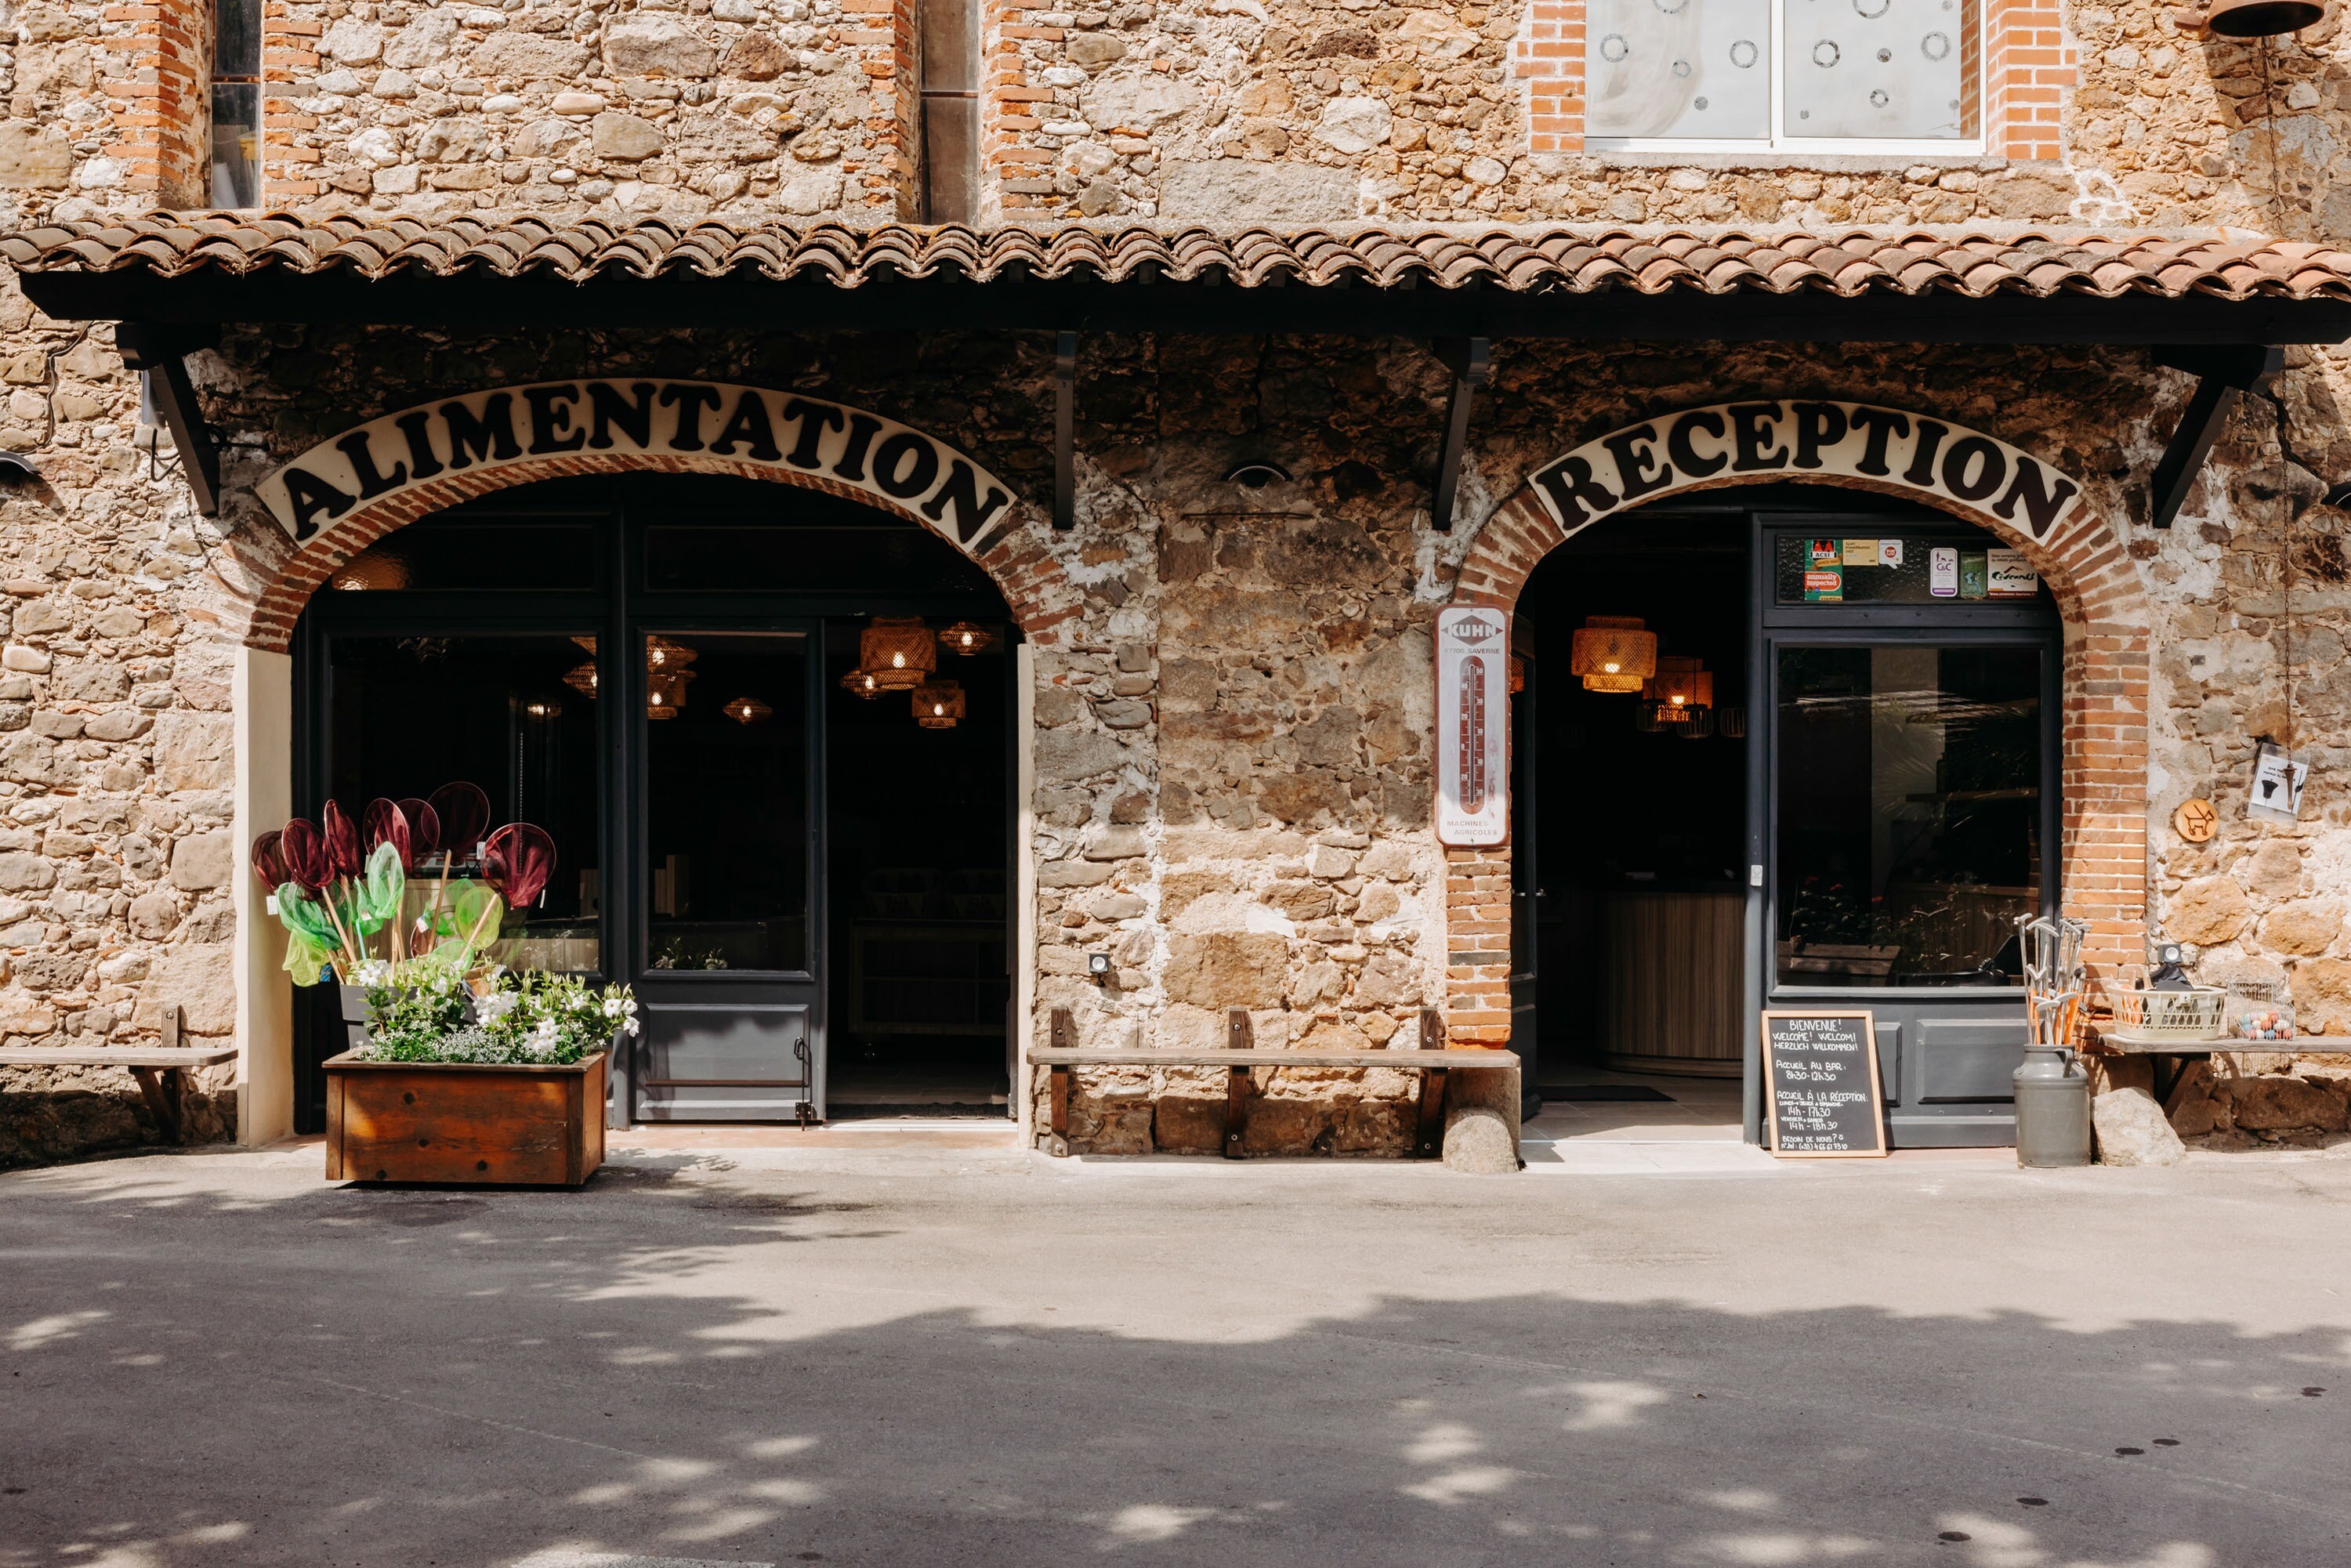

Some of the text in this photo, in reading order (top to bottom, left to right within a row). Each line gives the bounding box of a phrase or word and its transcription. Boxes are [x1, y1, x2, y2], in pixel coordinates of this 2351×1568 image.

[282, 382, 1009, 545] ALIMENTATION
[1534, 401, 2078, 538] RECEPTION
[1936, 563, 1951, 571] C&C
[1447, 624, 1496, 637] KUHN
[1789, 1019, 1842, 1032] BIENVENUE!
[1772, 1031, 1857, 1042] WELCOME! WELCOM!
[1810, 1062, 1823, 1070] AU
[1807, 1089, 1814, 1101] À
[1817, 1092, 1828, 1102] LA
[1788, 1106, 1802, 1116] 14h
[1808, 1106, 1831, 1117] 17h30
[1789, 1121, 1805, 1131] 14h
[1816, 1133, 1838, 1143] NOUS?
